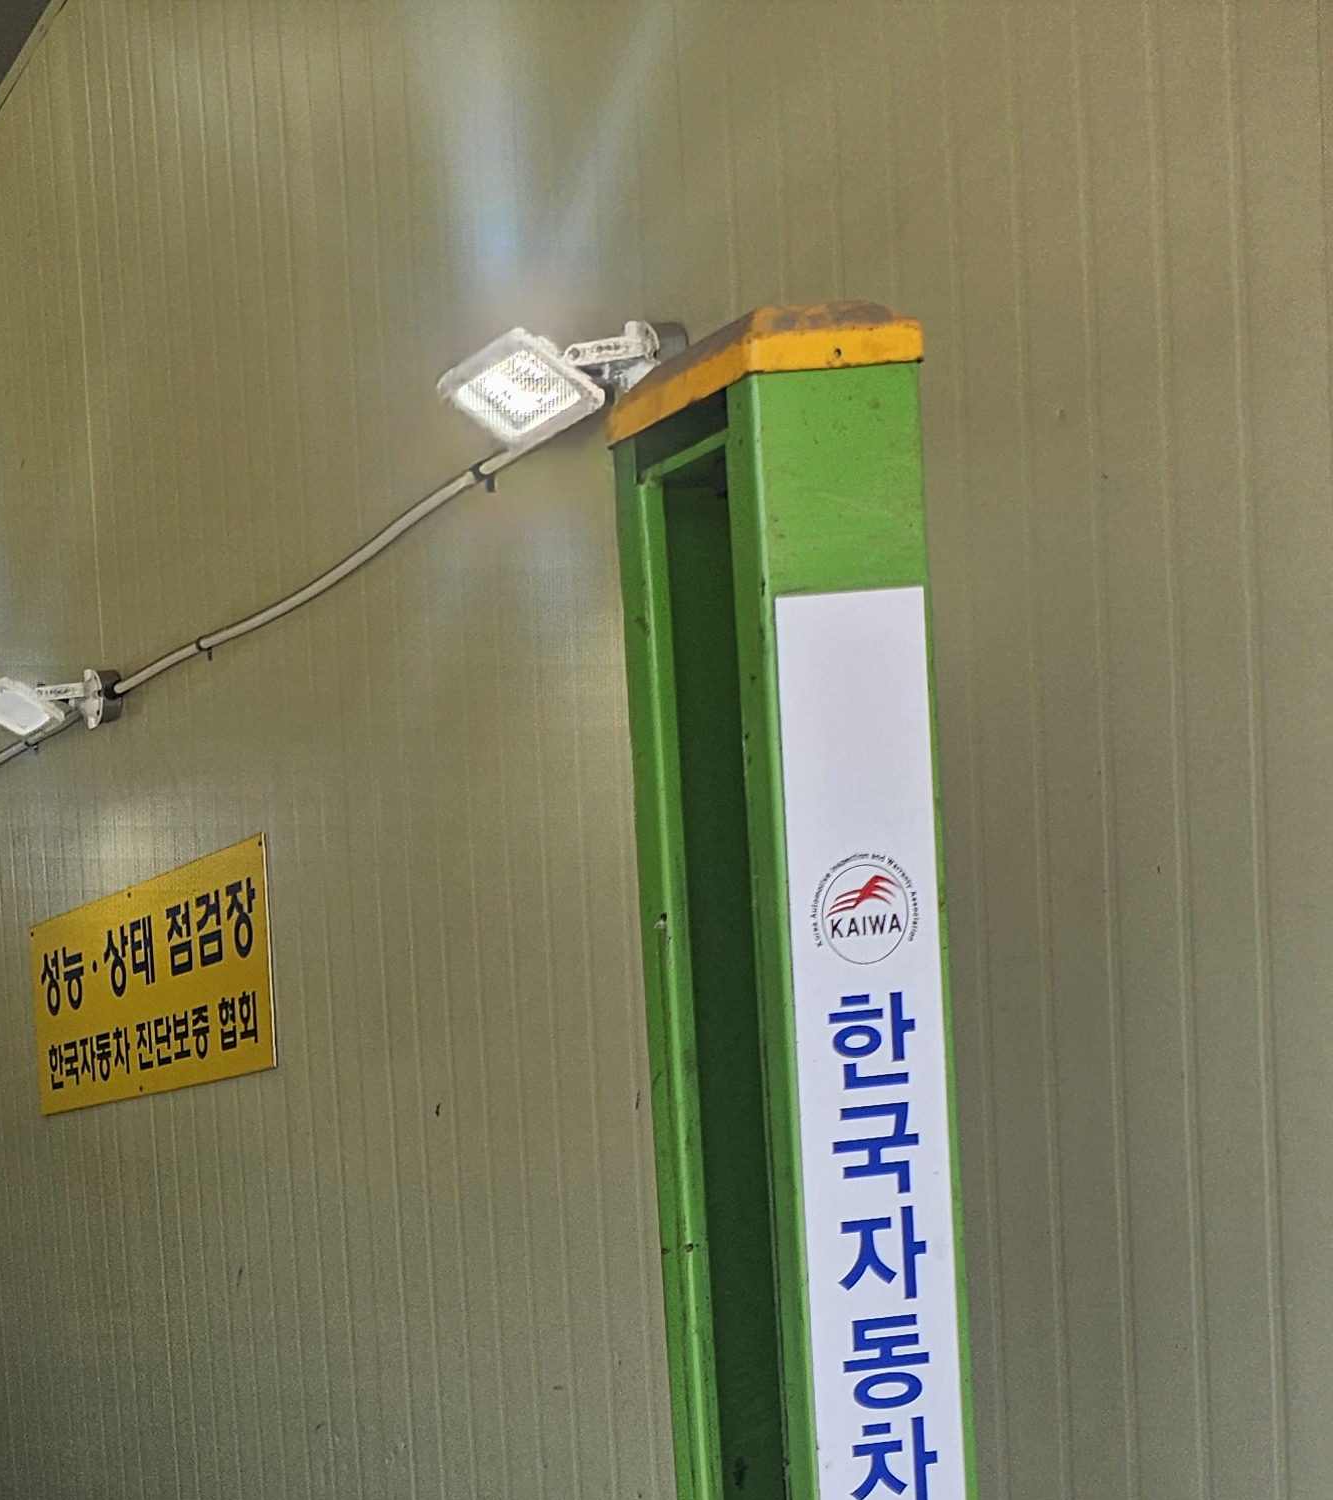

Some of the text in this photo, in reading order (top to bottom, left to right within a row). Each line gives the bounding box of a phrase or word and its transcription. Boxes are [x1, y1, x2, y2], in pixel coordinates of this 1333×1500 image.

[165, 877, 256, 978] 점검장
[830, 913, 902, 939] KAIWA
[48, 991, 258, 1091] 한국자동차 진단보증 협회
